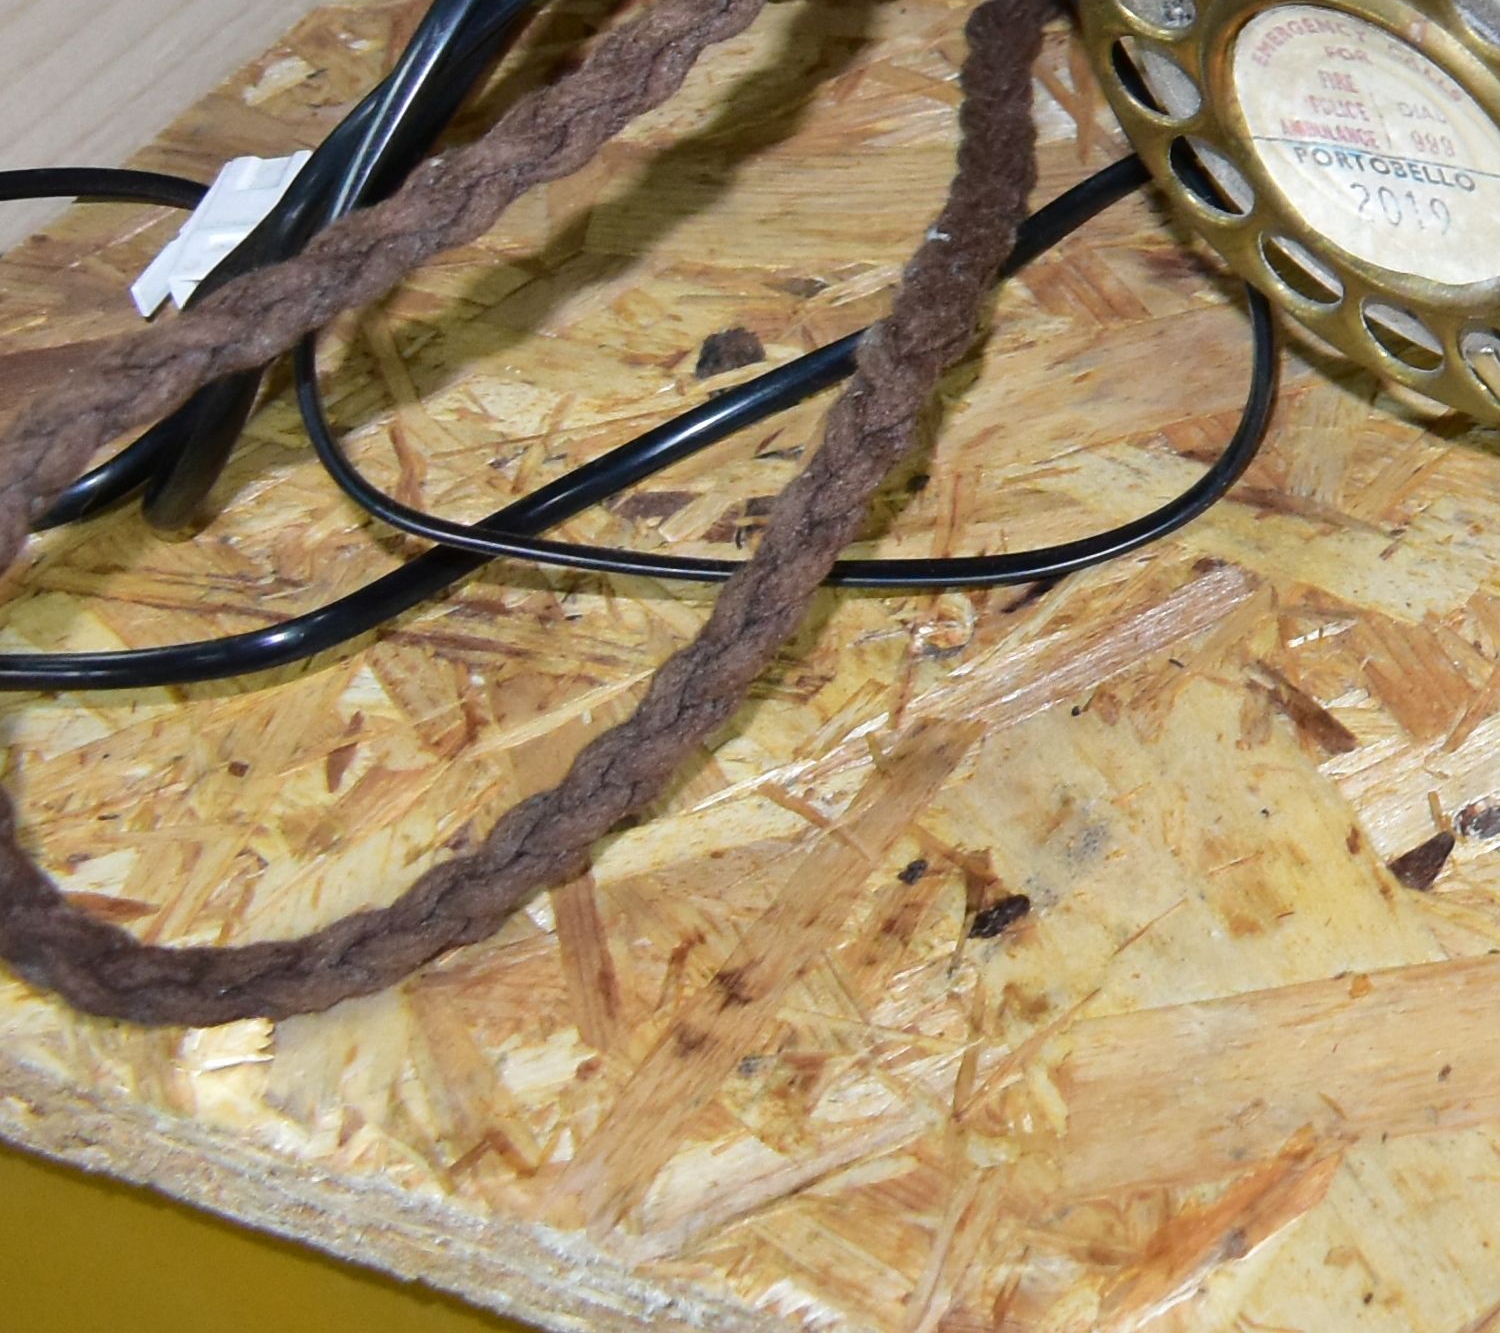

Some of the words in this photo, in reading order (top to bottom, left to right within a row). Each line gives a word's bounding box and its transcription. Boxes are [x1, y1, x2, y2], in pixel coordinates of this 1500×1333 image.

[1251, 17, 1368, 68] EMERGENCY
[1323, 44, 1375, 65] FOR
[1317, 69, 1360, 94] FIRE
[1292, 145, 1477, 193] PORTOBELLO
